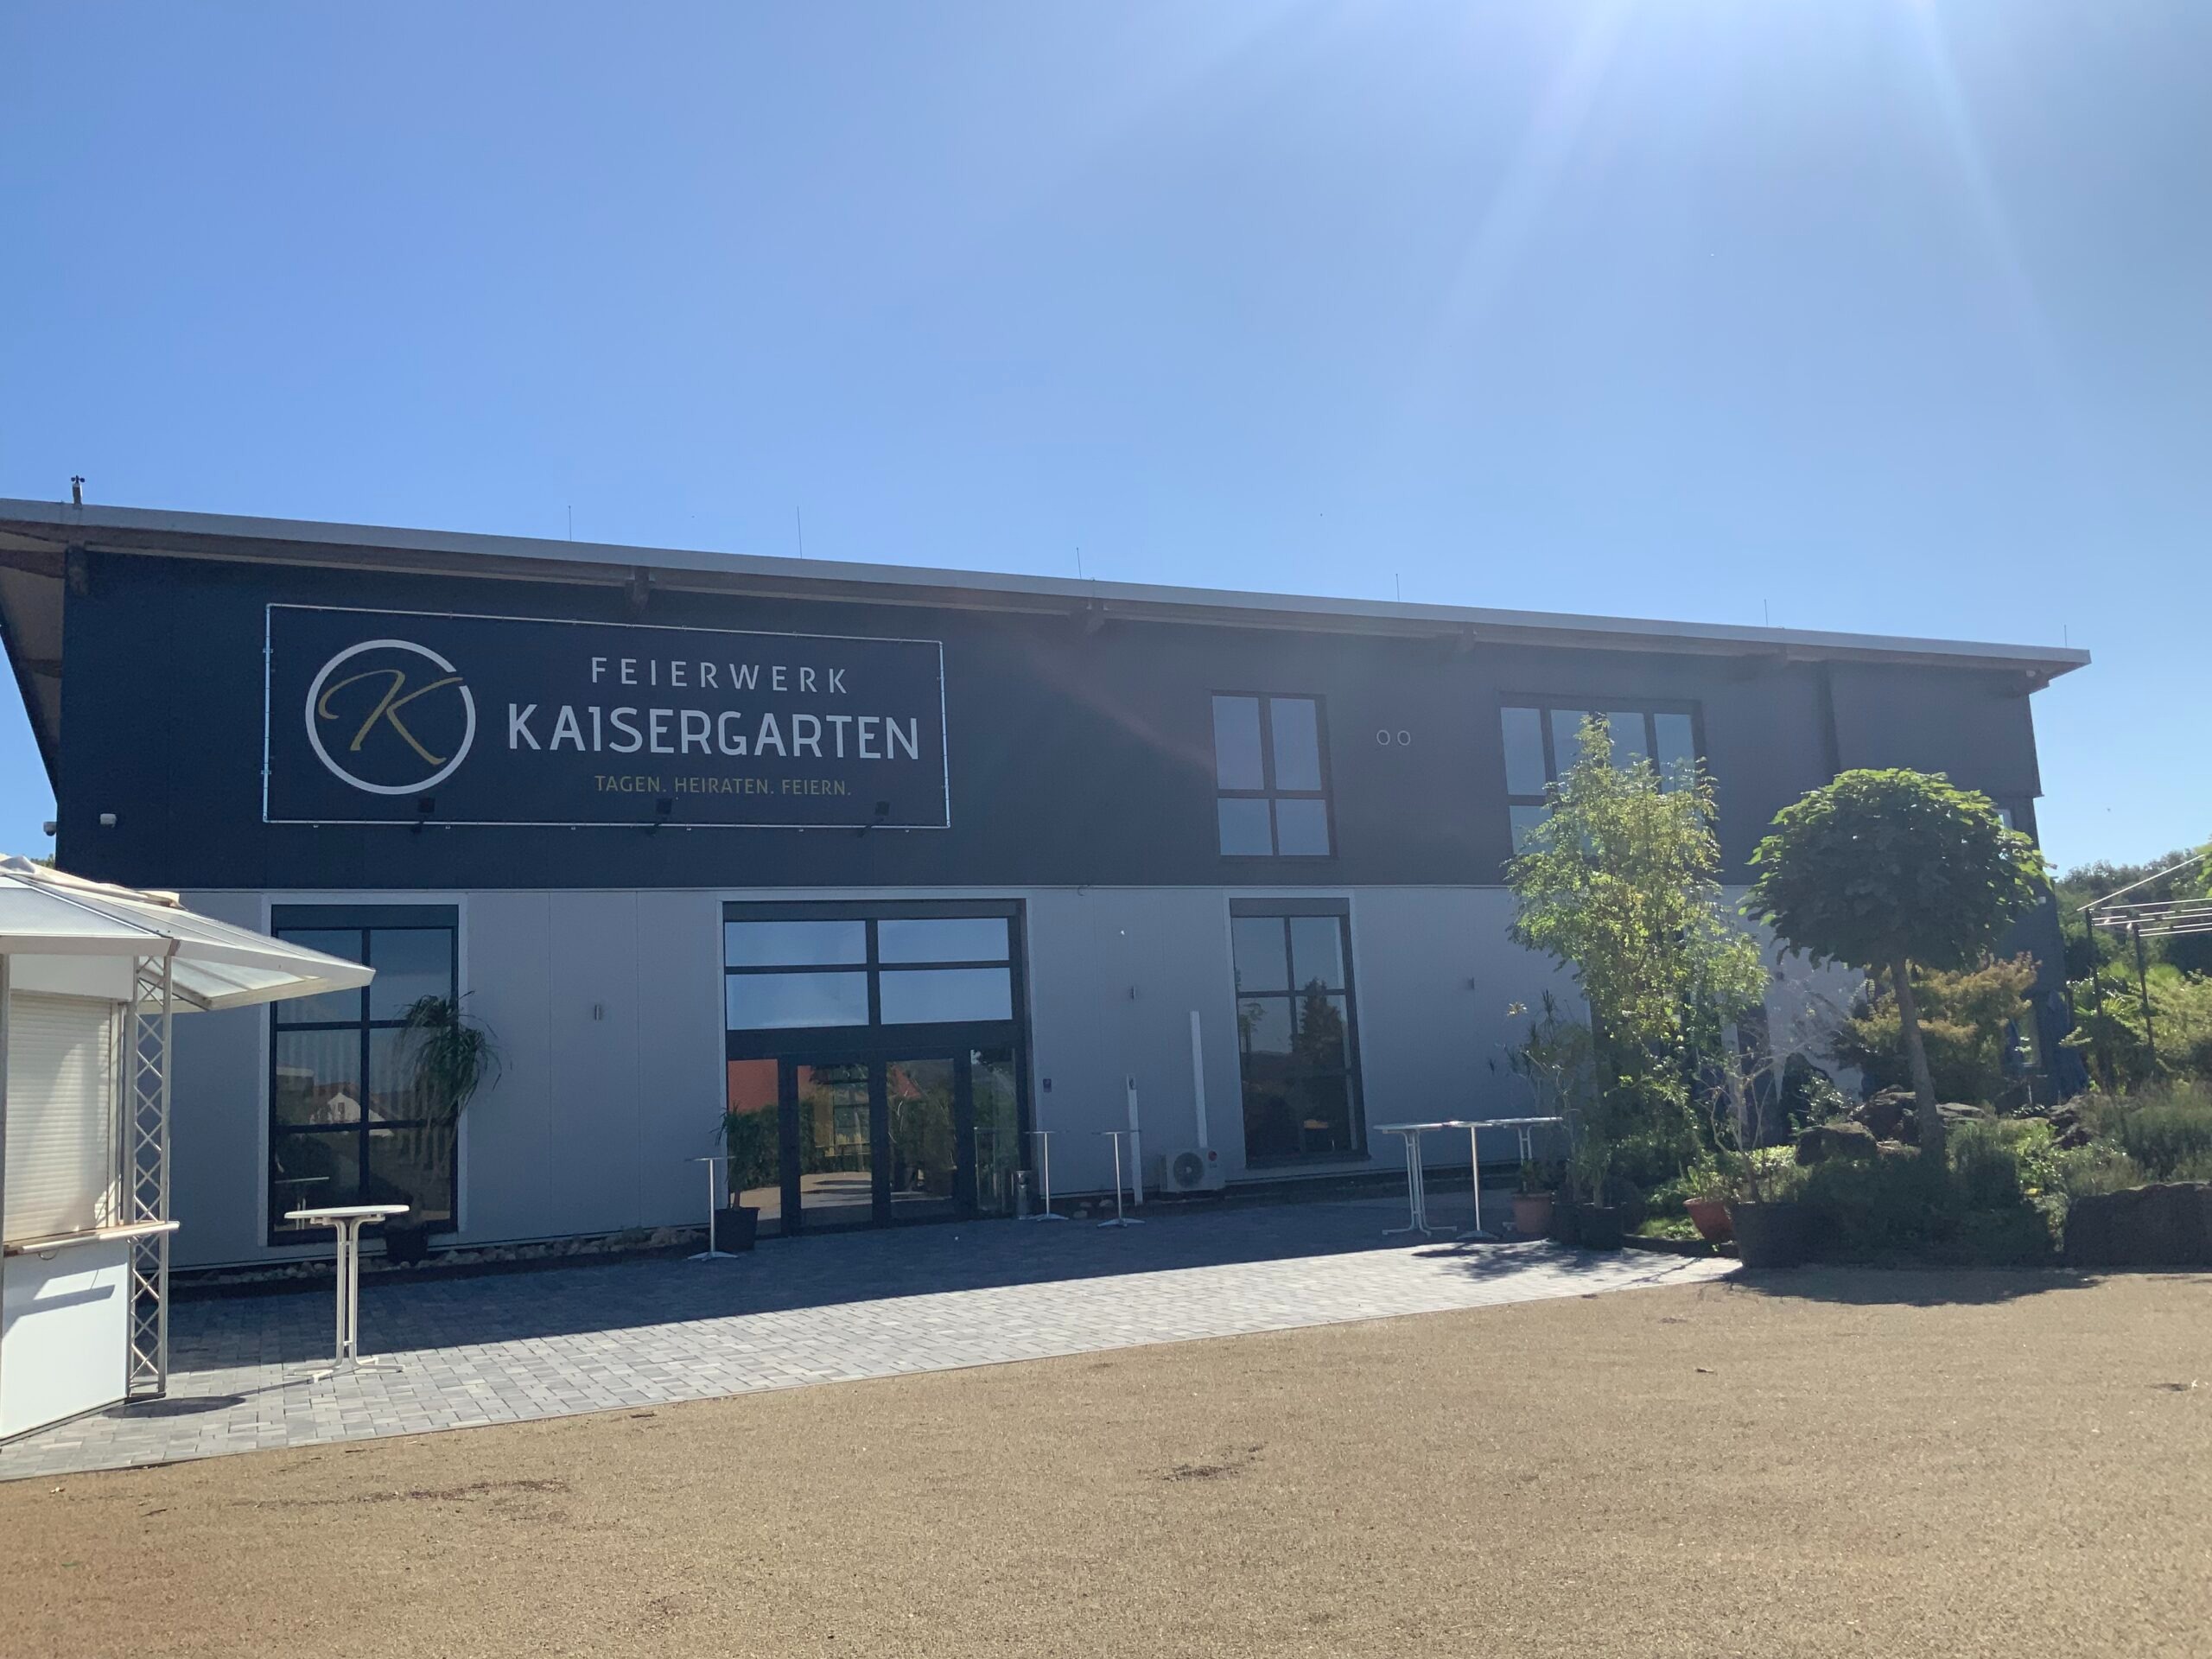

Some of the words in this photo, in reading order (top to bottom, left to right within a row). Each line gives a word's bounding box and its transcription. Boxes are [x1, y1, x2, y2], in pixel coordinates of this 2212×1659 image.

[591, 657, 848, 694] FEIERWERK
[318, 669, 464, 765] K
[508, 703, 918, 760] KAISERGARTEN
[594, 775, 667, 793] TAGEN.
[674, 777, 774, 794] HEIRATEN.
[781, 779, 851, 796] FEIERN.
